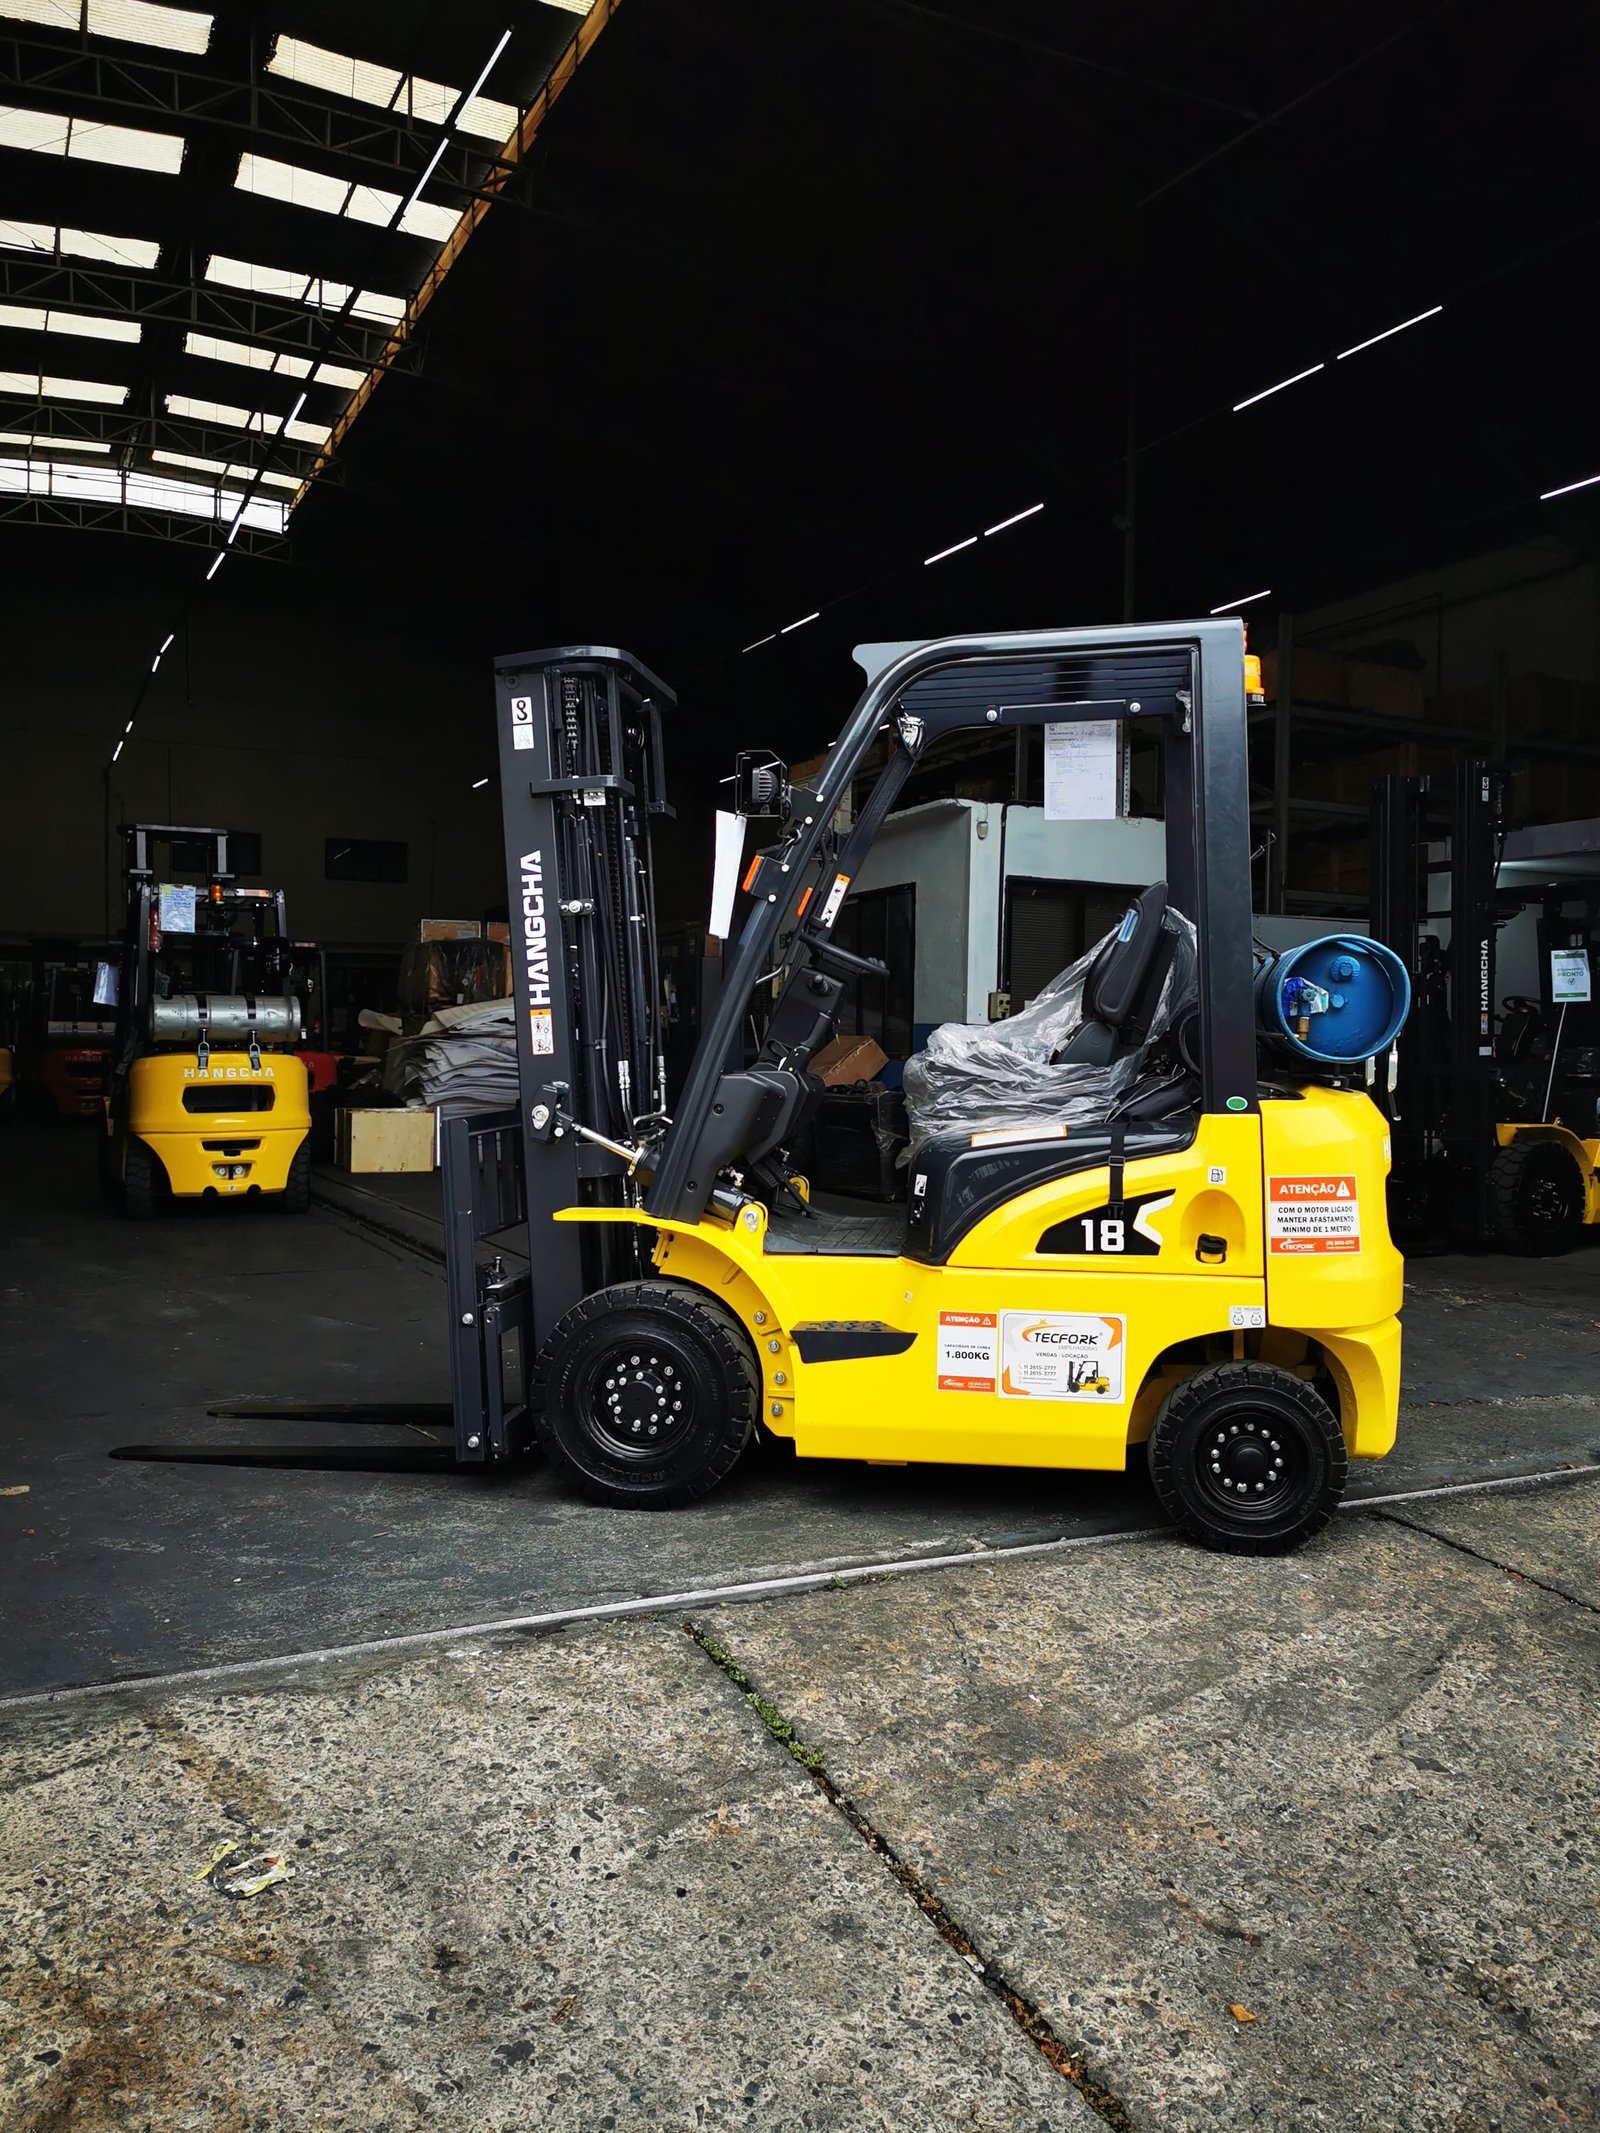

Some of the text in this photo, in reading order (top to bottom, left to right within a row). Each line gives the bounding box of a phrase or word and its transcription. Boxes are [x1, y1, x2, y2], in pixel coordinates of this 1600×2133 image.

[520, 850, 551, 1005] HANGCHA
[183, 1067, 275, 1078] HANGCHA
[1279, 1182, 1336, 1196] ATENÇÃO
[1278, 1205, 1353, 1214] COM O MOTOR LIGADO
[1309, 1215, 1355, 1223] AFASTAMENTO
[1282, 1225, 1312, 1233] MÍNIMO
[1330, 1225, 1352, 1233] METRO
[1081, 1219, 1124, 1251] 18
[945, 1315, 980, 1324] ATENÇÃO
[1034, 1332, 1099, 1345] TECFORK
[945, 1350, 990, 1360] 1.800KG
